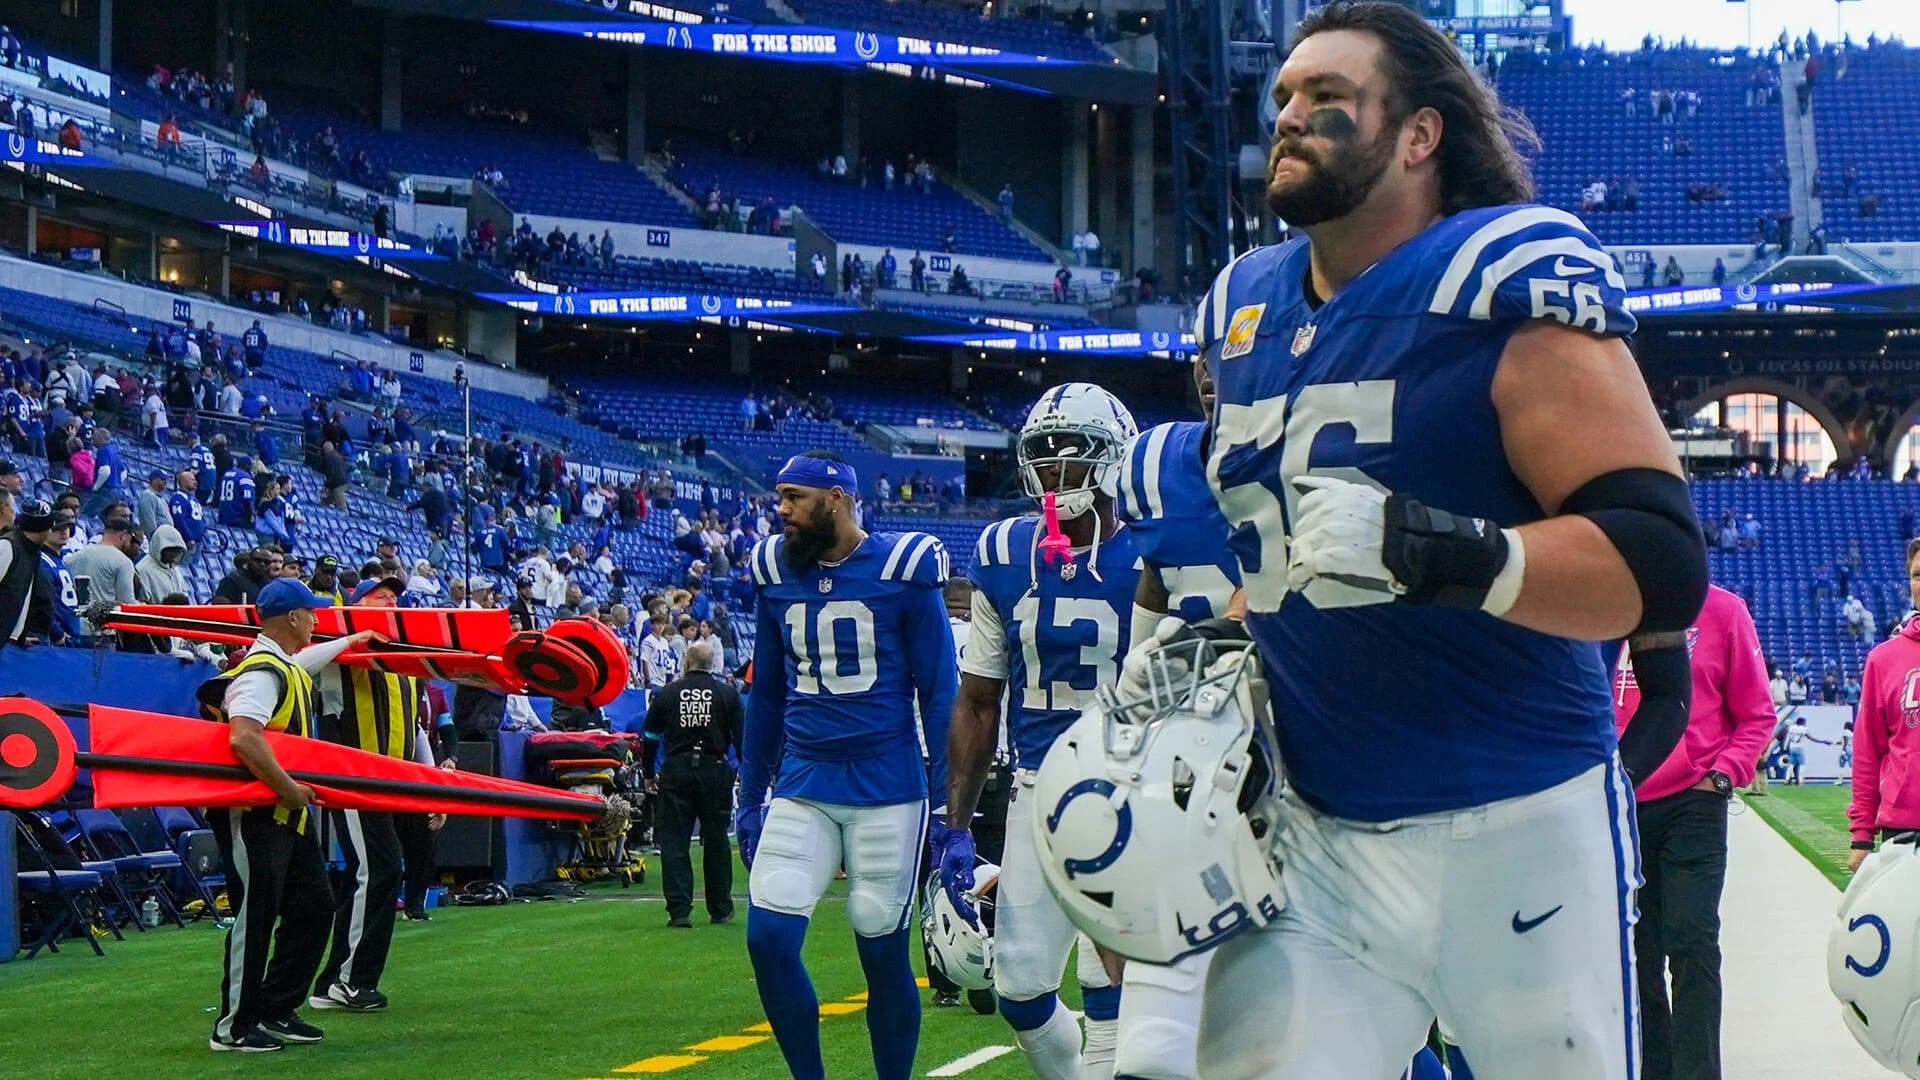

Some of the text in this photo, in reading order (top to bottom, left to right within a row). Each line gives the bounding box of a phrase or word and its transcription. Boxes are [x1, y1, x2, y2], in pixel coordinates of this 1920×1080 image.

[651, 4, 674, 20] THE
[712, 33, 837, 53] FOR THE SHOE
[290, 228, 350, 247] FOR THE SHOE
[649, 232, 668, 244] 347
[1627, 254, 1646, 263] 451
[590, 296, 687, 314] FOR THE SHOE
[1529, 278, 1607, 334] 56
[1653, 292, 1682, 308] THE
[1683, 288, 1722, 304] SHOE
[174, 302, 189, 317] 244
[1058, 333, 1142, 350] FOR THE SHOE
[411, 356, 422, 369] 245
[1759, 361, 1809, 373] LUCAS
[1816, 361, 1841, 372] OIL
[220, 480, 234, 501] 18
[1206, 379, 1396, 614] 56
[785, 600, 878, 695] 10
[1013, 597, 1119, 710] 13
[680, 688, 713, 701] CSC
[680, 701, 712, 714] EVENT
[680, 714, 711, 728] STAFF
